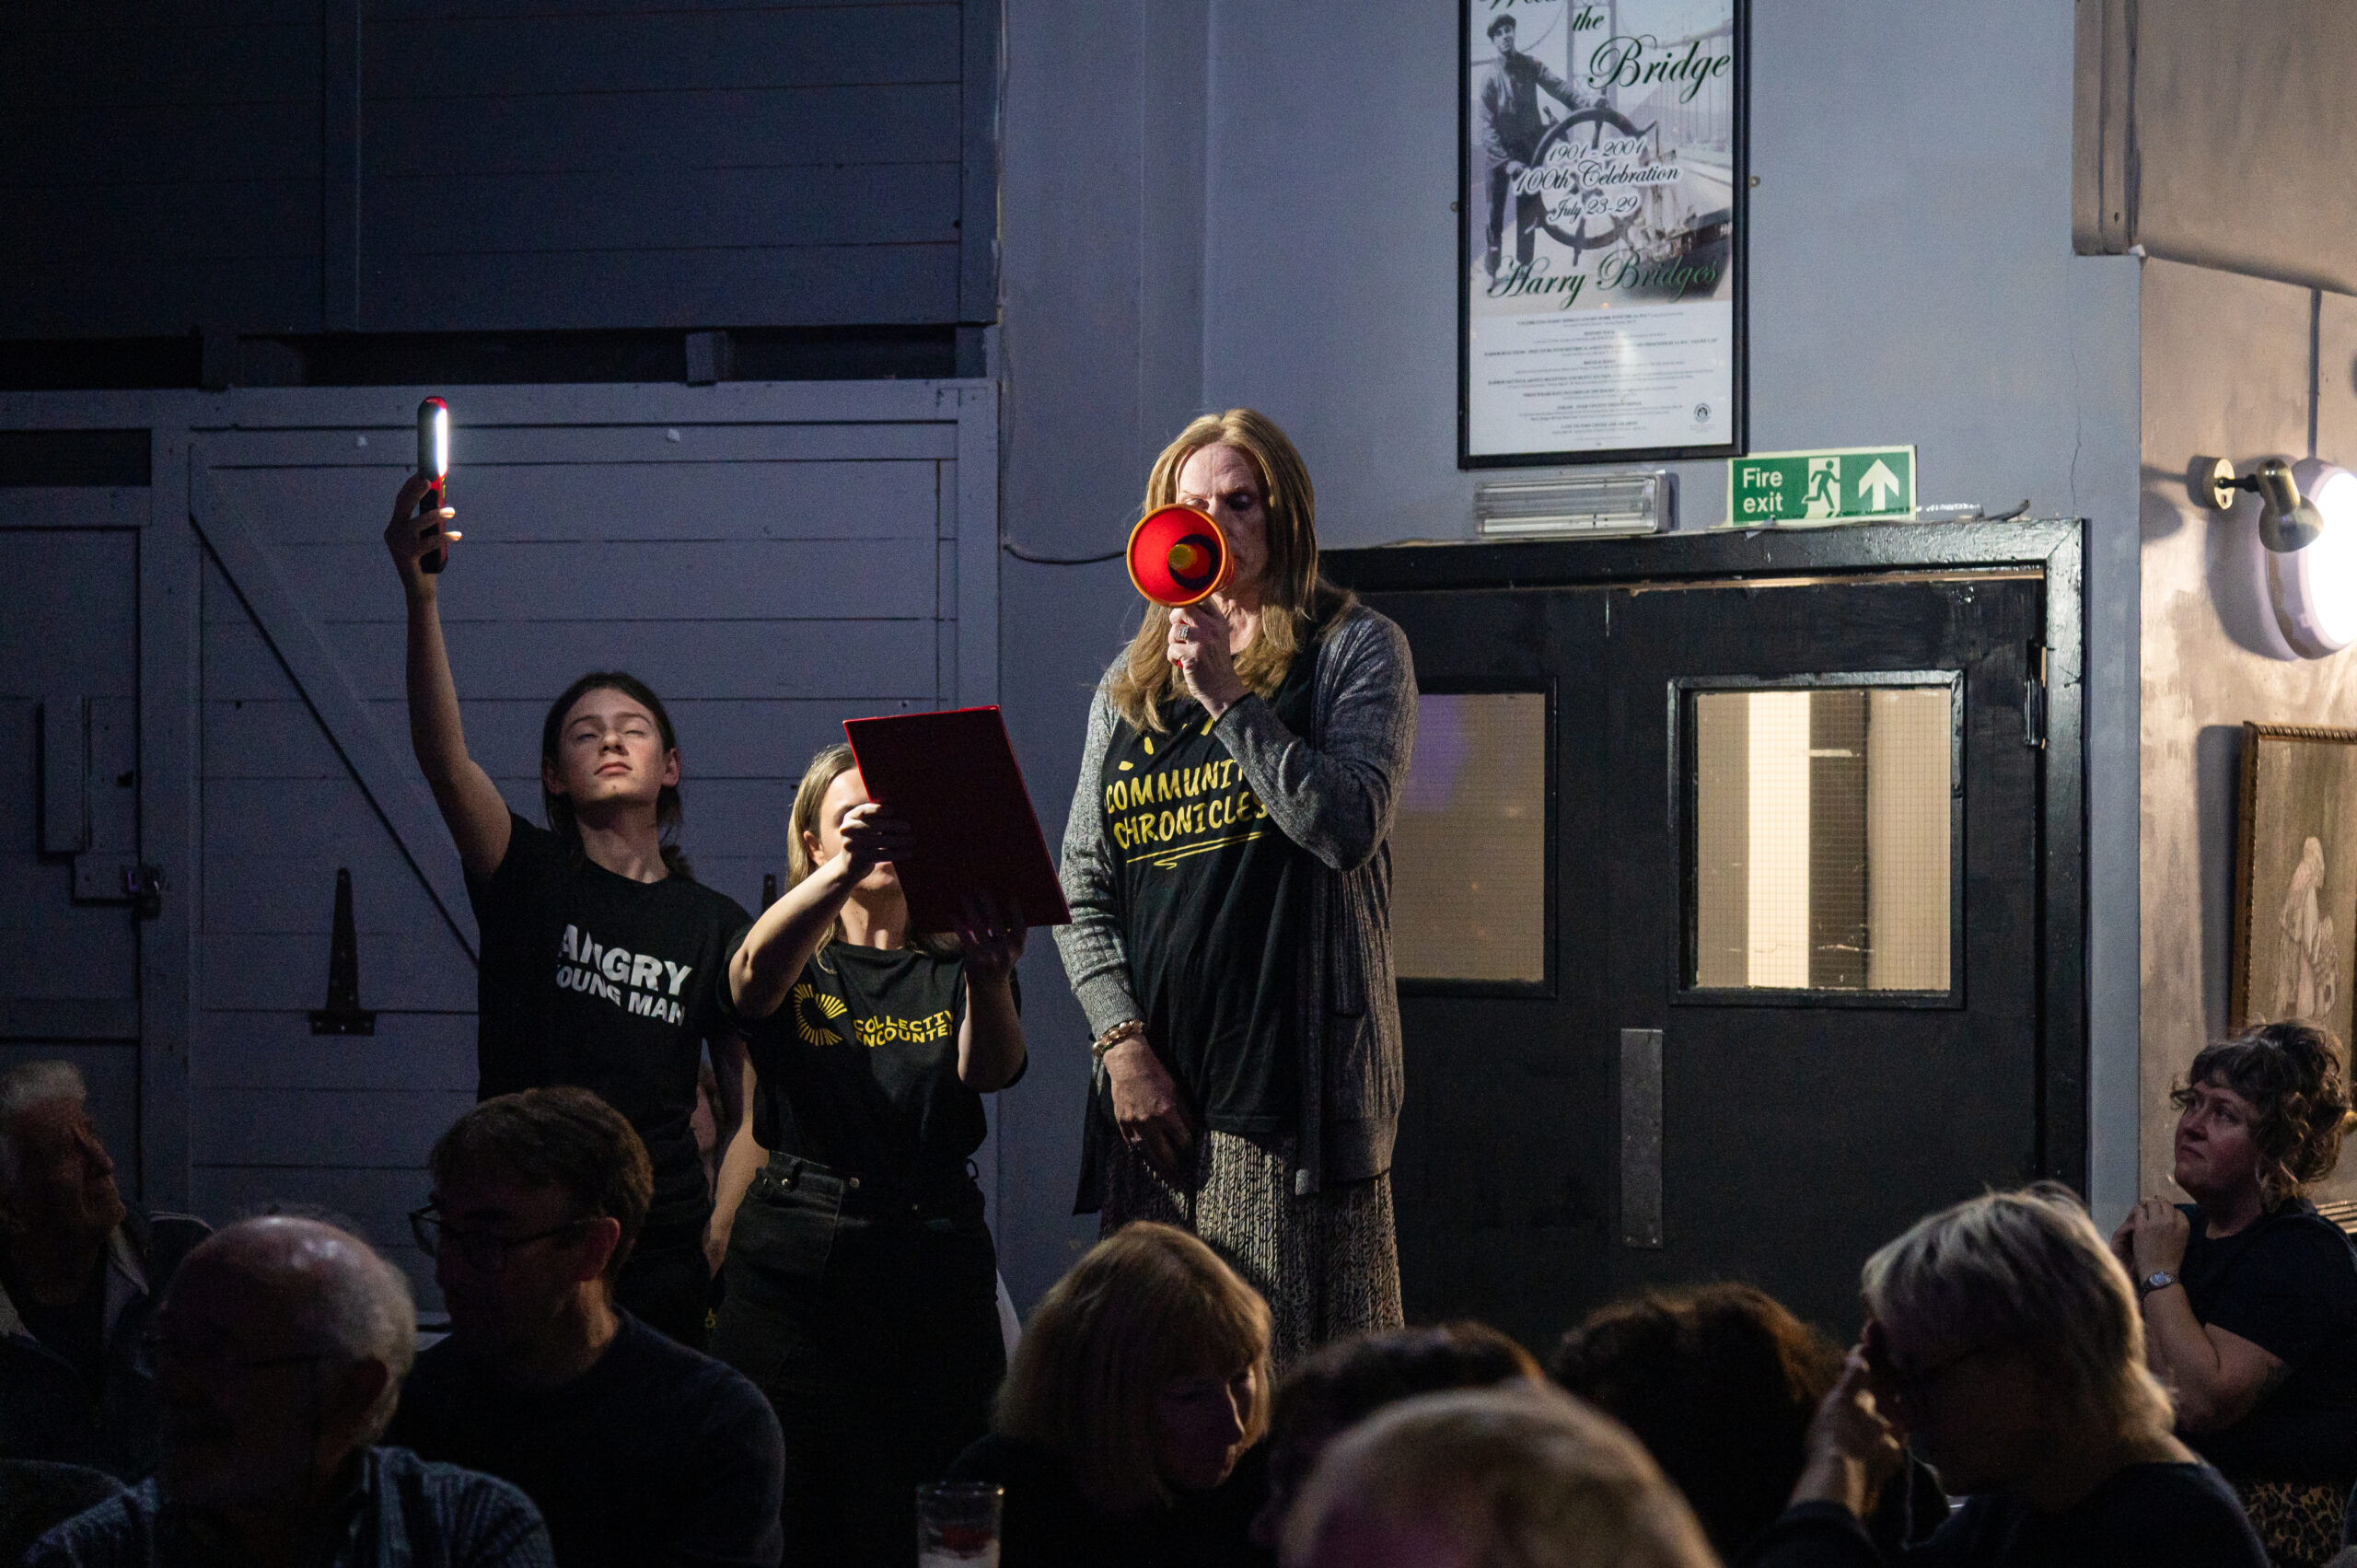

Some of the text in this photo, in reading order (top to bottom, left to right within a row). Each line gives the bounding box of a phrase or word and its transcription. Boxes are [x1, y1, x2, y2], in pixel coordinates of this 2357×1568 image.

[1572, 6, 1605, 31] the
[1587, 34, 1731, 104] Bridge
[1550, 144, 1588, 162] 1901
[1602, 139, 1644, 157] 2001
[1515, 159, 1679, 192] 100th Celebration
[1549, 198, 1582, 224] July
[1487, 249, 1717, 309] Harry Bridges
[1743, 468, 1783, 488] Fire
[1743, 492, 1783, 513] exit
[1113, 791, 1269, 850] CHRONICLES
[558, 923, 693, 996] ANGRY
[556, 965, 686, 1027] OUNG MAN
[853, 1010, 954, 1033] COLLECTIV
[854, 1024, 954, 1048] ENCOUNTE
